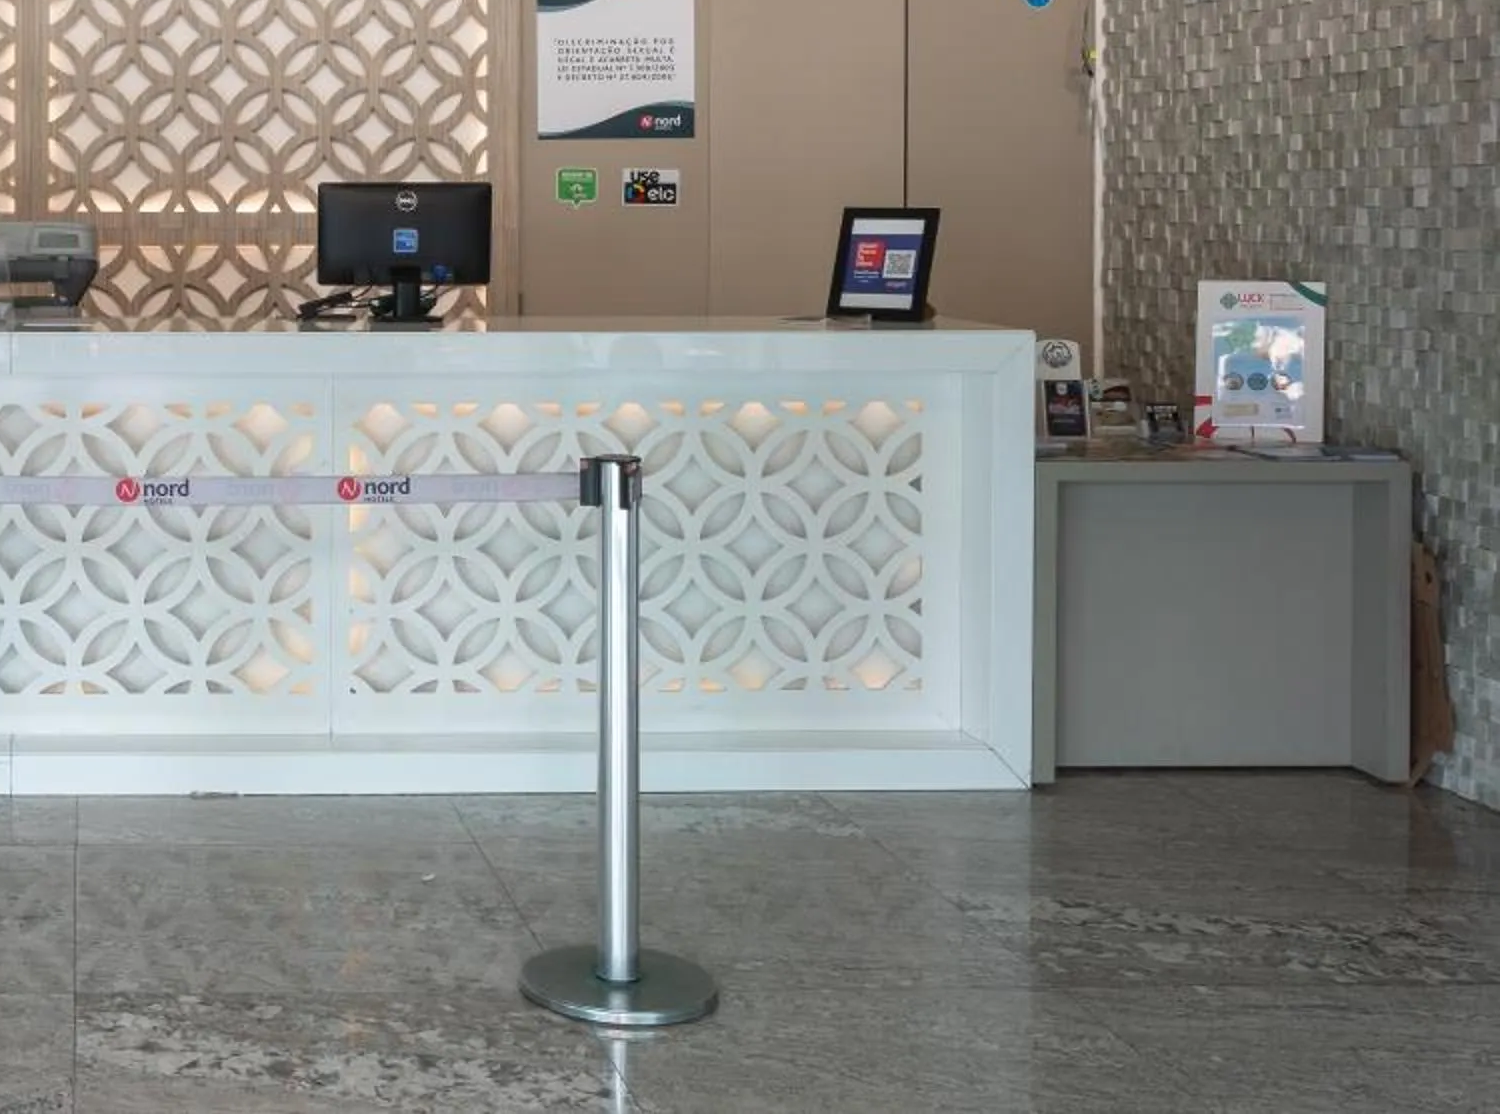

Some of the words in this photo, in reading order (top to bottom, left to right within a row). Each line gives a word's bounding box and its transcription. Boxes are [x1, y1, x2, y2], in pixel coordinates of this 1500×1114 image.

[655, 114, 681, 126] nord
[143, 478, 189, 497] nord
[365, 476, 411, 494] nord
